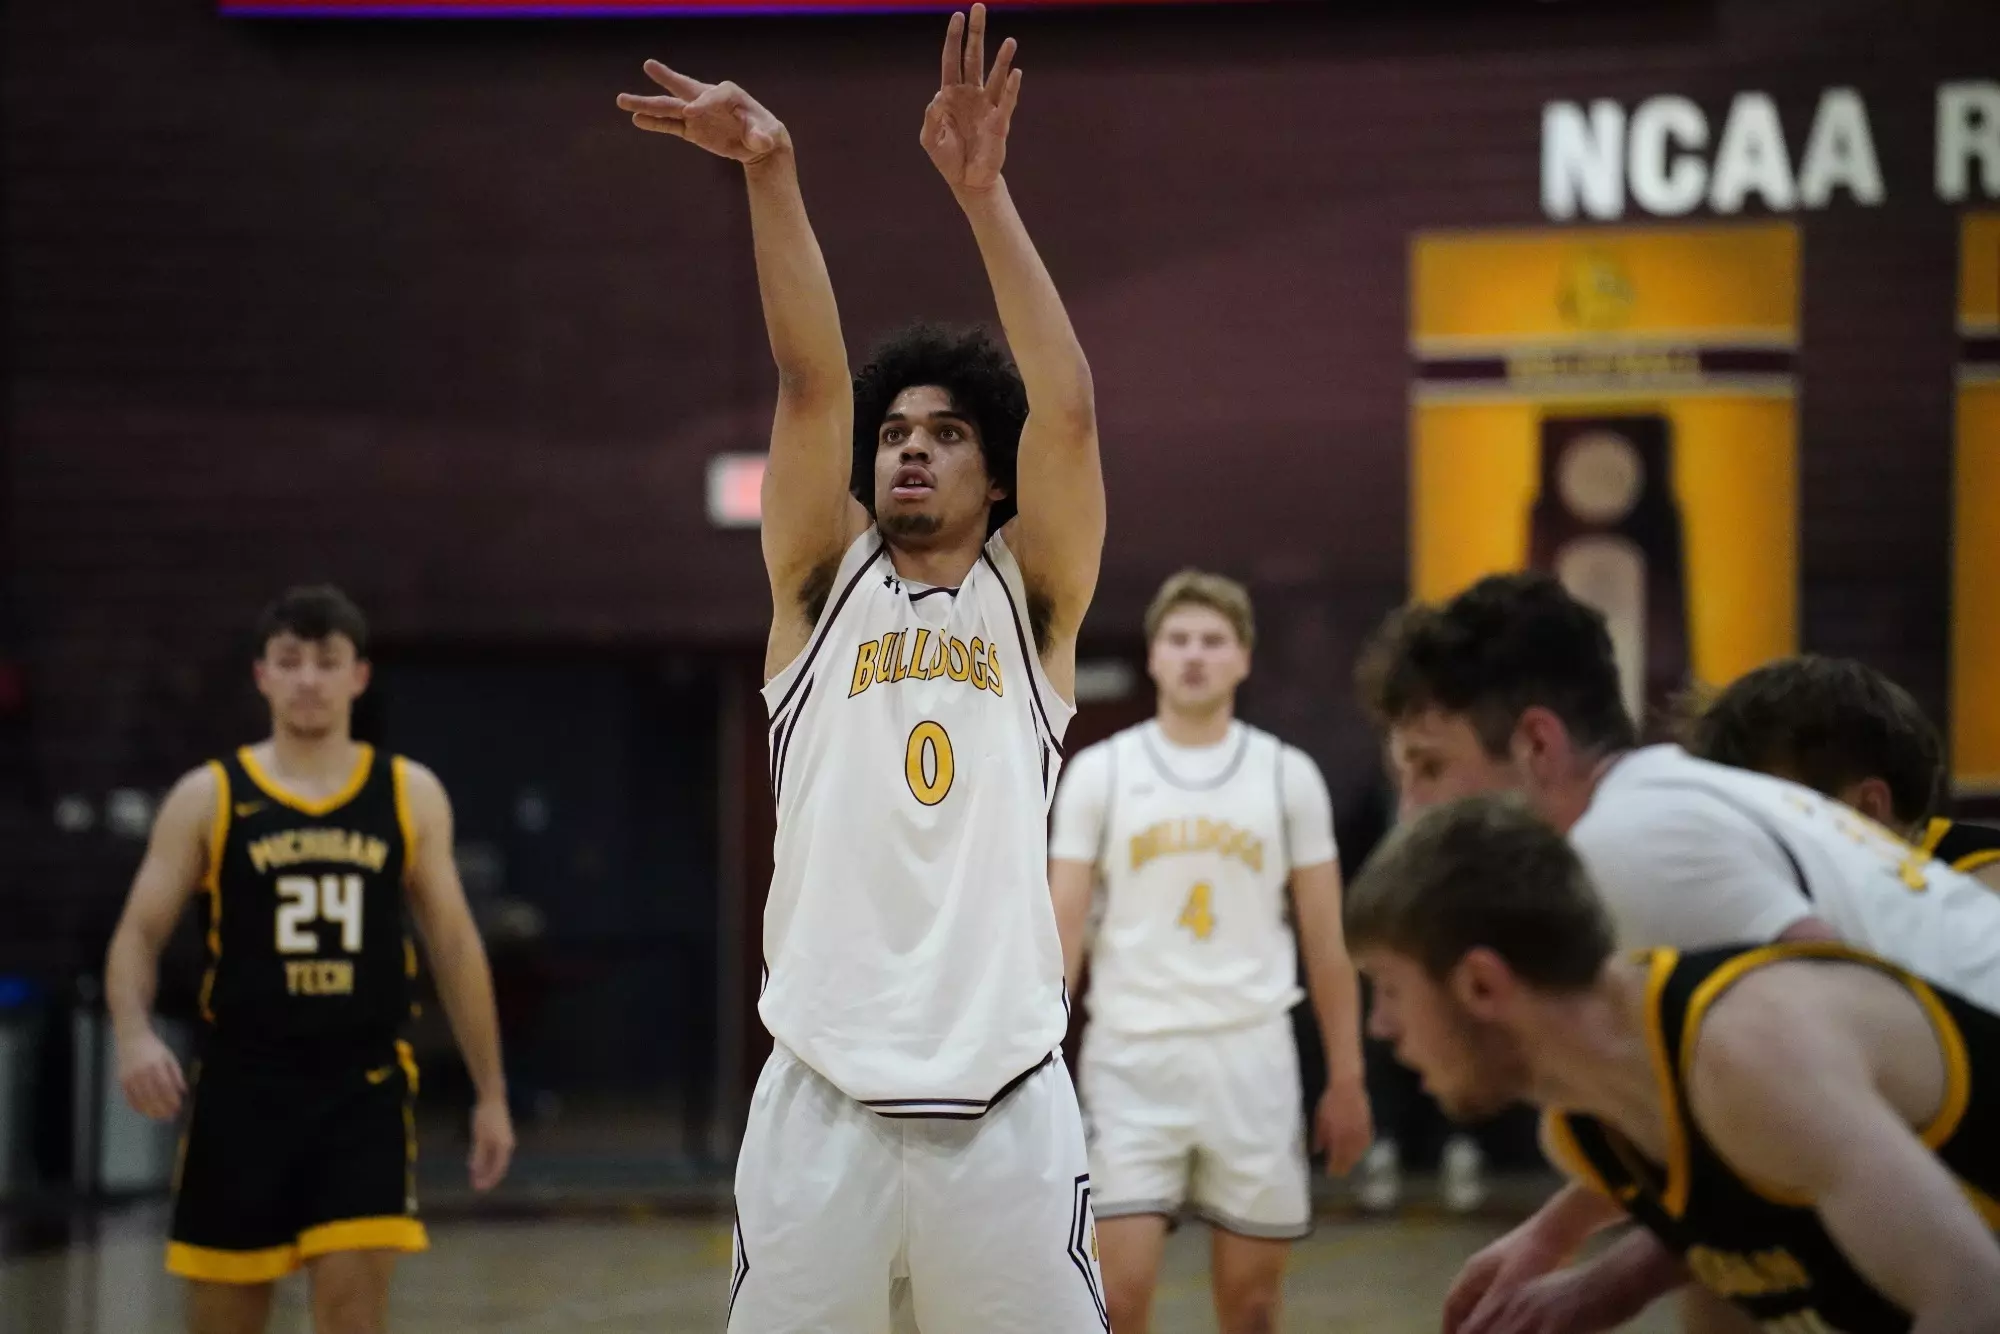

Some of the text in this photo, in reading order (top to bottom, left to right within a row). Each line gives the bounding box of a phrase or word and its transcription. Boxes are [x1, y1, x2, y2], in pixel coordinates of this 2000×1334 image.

[1541, 89, 1884, 220] NCAA
[848, 627, 1004, 699] BULLDOGS
[904, 720, 955, 807] 0
[247, 828, 388, 874] MICHIGAN
[1129, 817, 1263, 873] BULLDOGS
[274, 873, 364, 954] 24
[1176, 880, 1217, 944] 4
[284, 959, 355, 996] TECH
